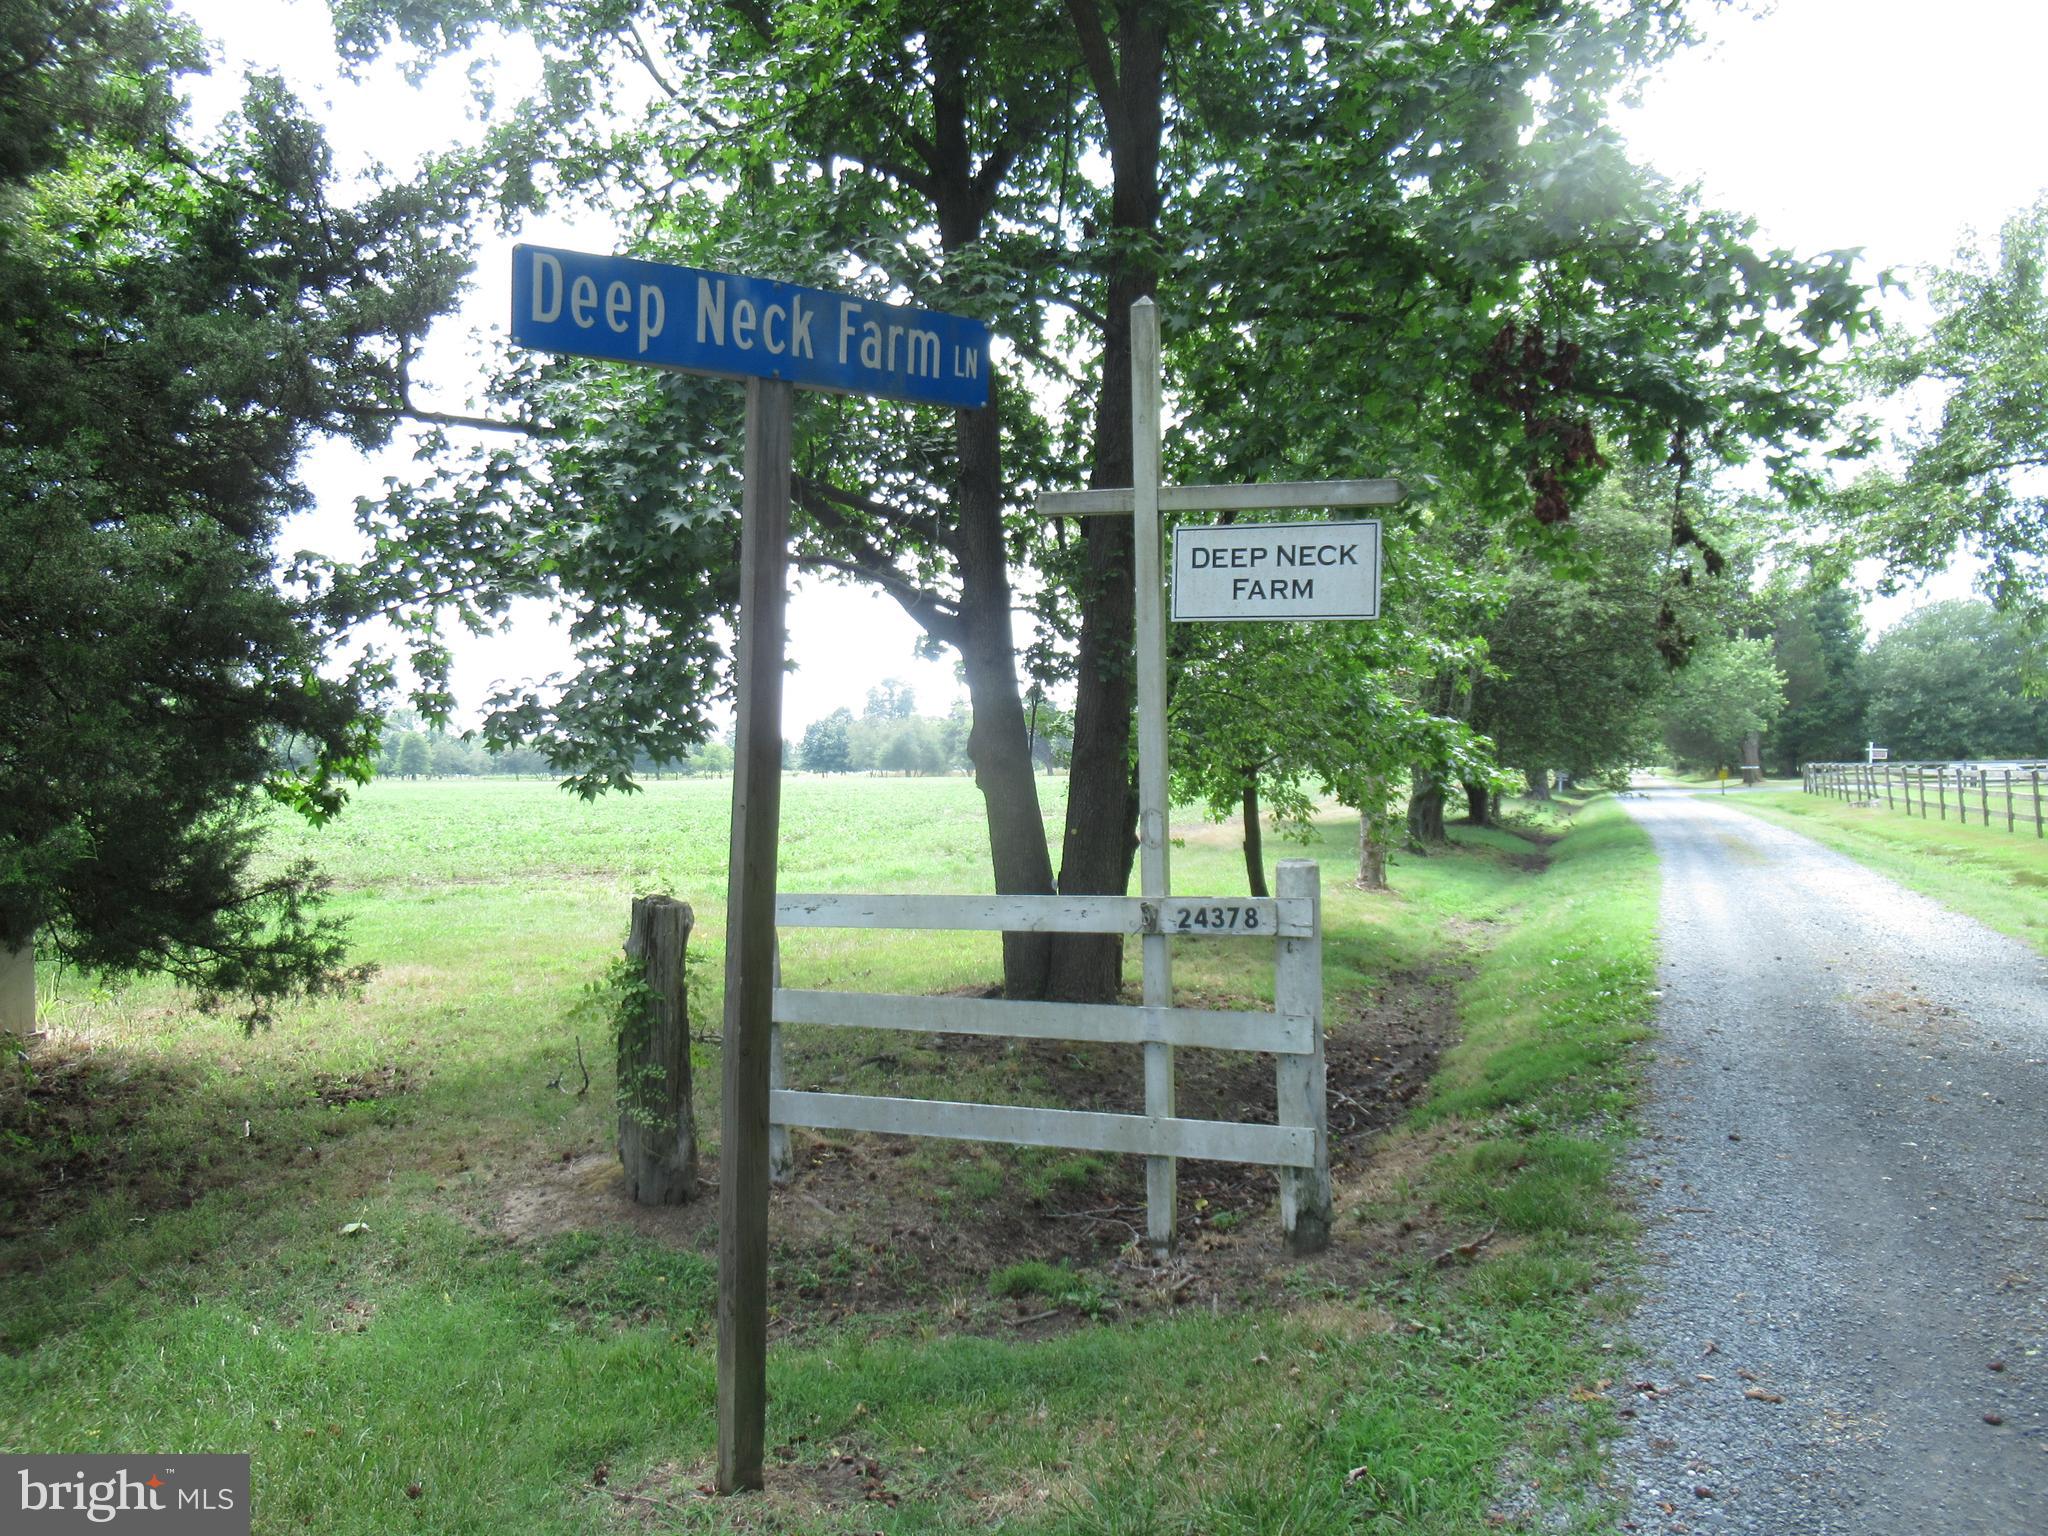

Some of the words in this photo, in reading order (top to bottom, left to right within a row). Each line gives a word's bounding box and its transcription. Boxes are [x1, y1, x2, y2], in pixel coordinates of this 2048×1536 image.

[532, 253, 665, 353] Deep
[696, 277, 815, 360] Neck
[839, 302, 941, 378] Farm
[954, 345, 978, 380] LN
[1192, 547, 1268, 568] DEEP
[1276, 544, 1358, 567] NECK
[1232, 578, 1314, 600] FARM
[1177, 907, 1259, 929] 24378
